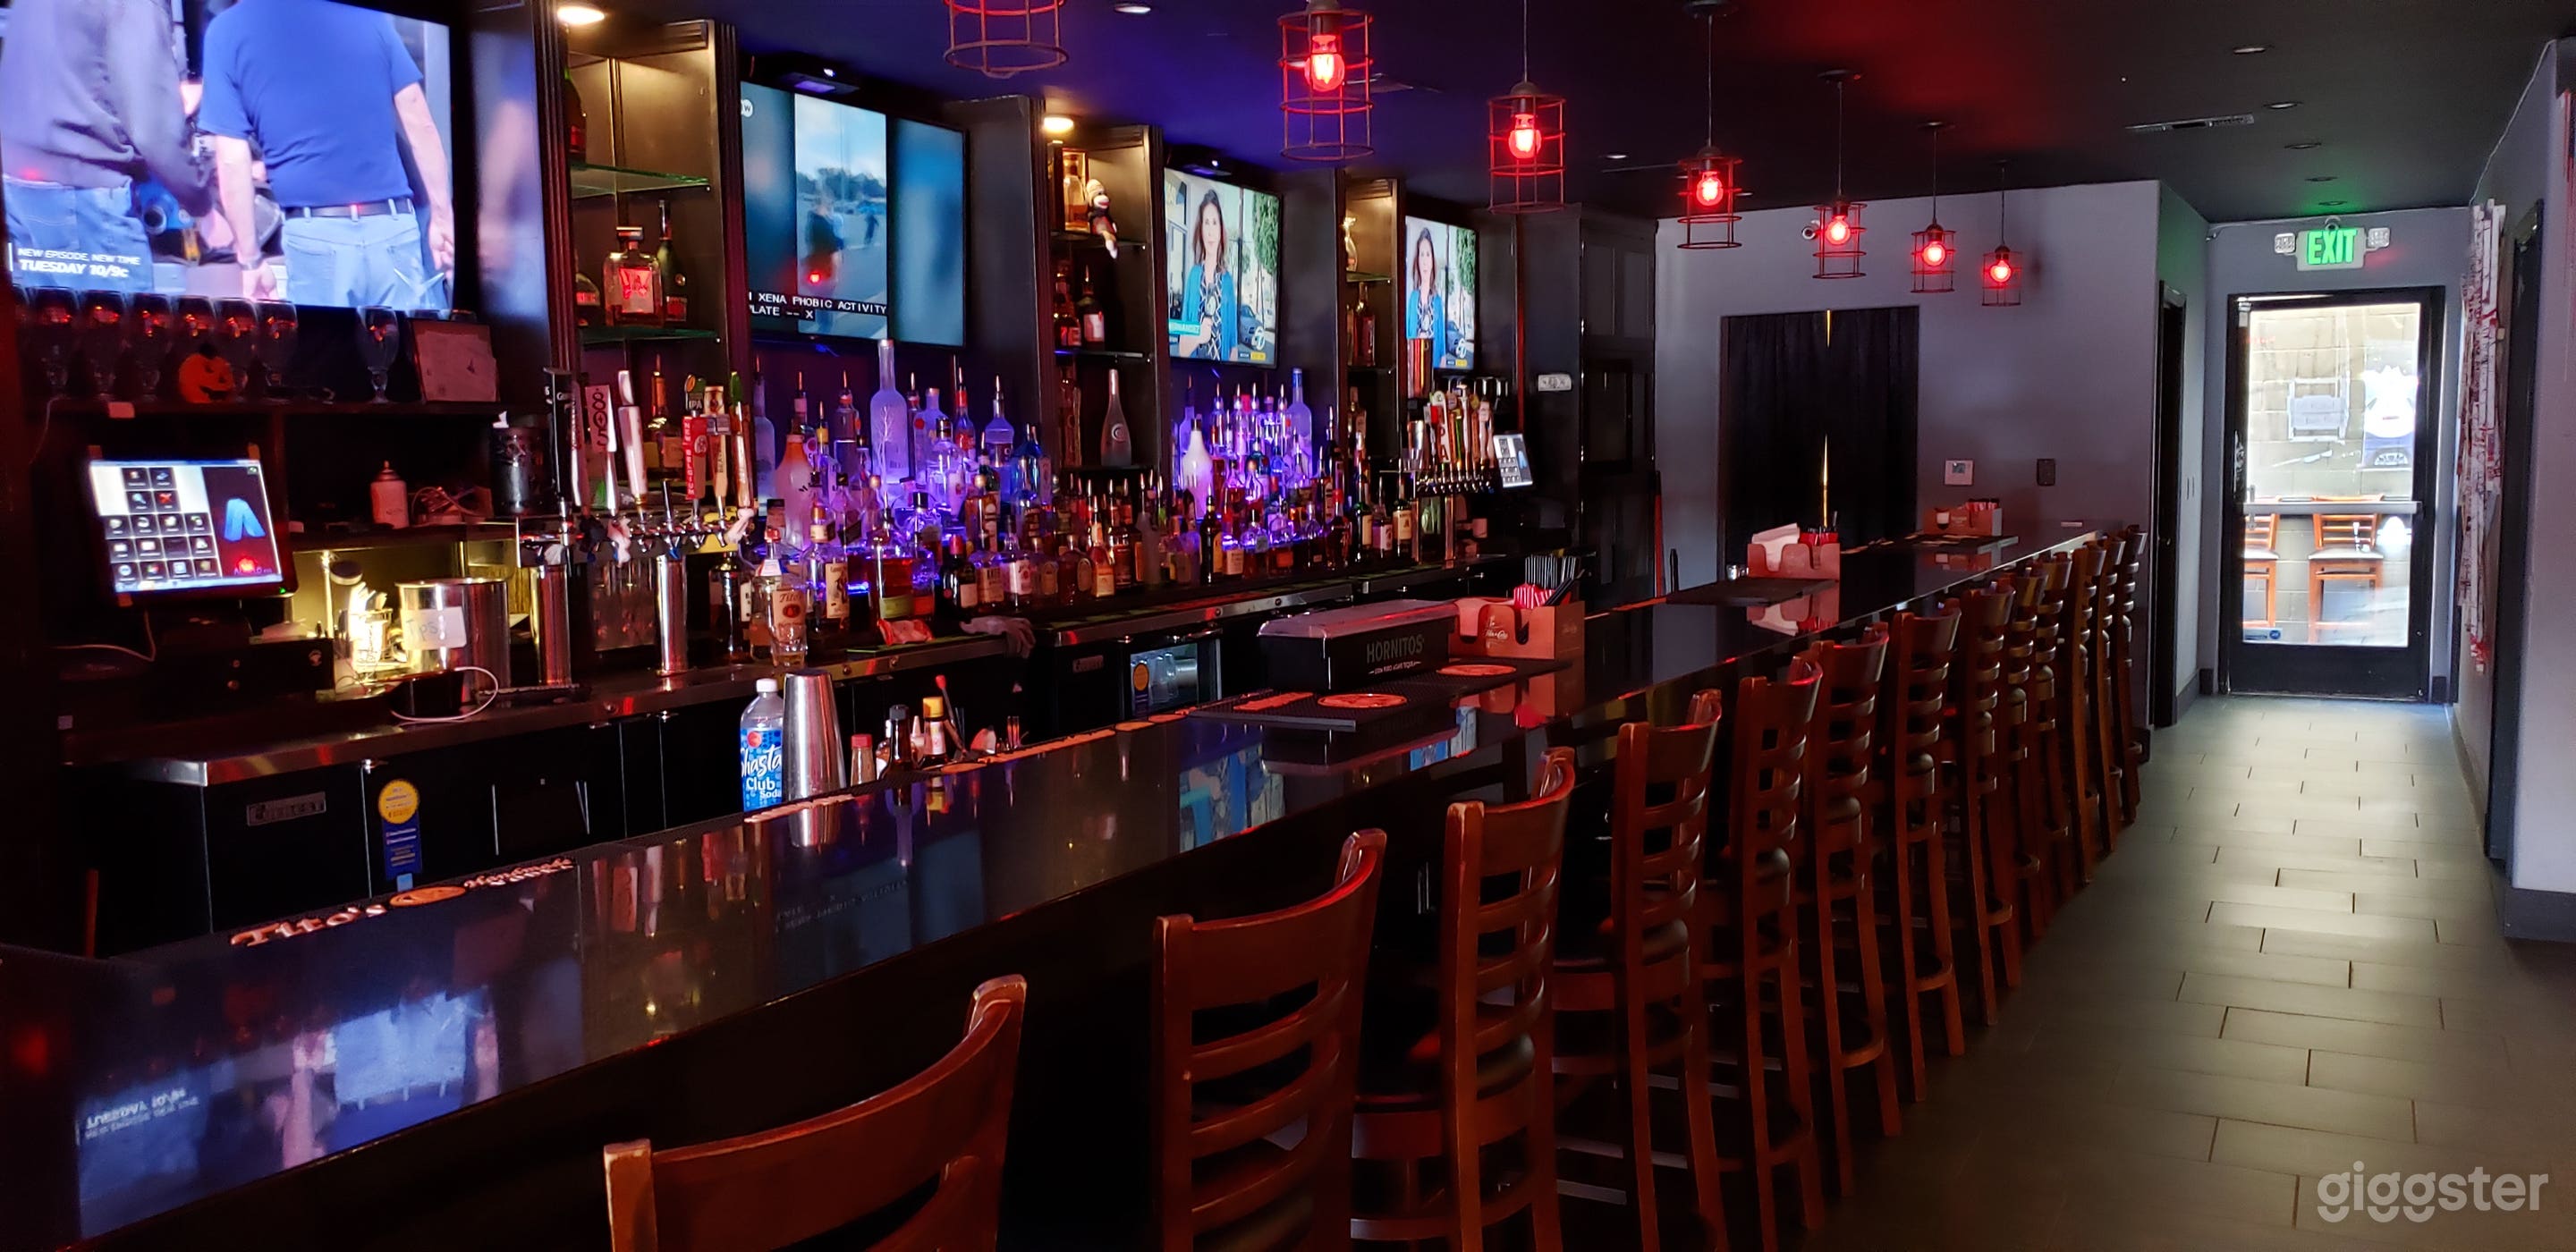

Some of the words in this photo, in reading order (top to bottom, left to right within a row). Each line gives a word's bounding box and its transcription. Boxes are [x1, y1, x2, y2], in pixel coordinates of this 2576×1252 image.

[18, 249, 44, 258] NEW
[91, 253, 114, 263] NEW
[116, 255, 140, 265] TIME
[2308, 229, 2357, 265] EXIT
[20, 259, 87, 274] TUESDAY
[89, 264, 130, 278] 10/9c
[758, 292, 787, 304] XENA
[792, 296, 833, 309] PHOBIC
[837, 301, 887, 315] ACTIVITY
[805, 309, 814, 319] X
[689, 400, 703, 410] IPA
[592, 392, 608, 446] 805
[685, 449, 695, 495] BELGIUM
[1367, 634, 1424, 664] HORNITOS
[746, 776, 775, 791] Club
[230, 904, 386, 947] Tito's
